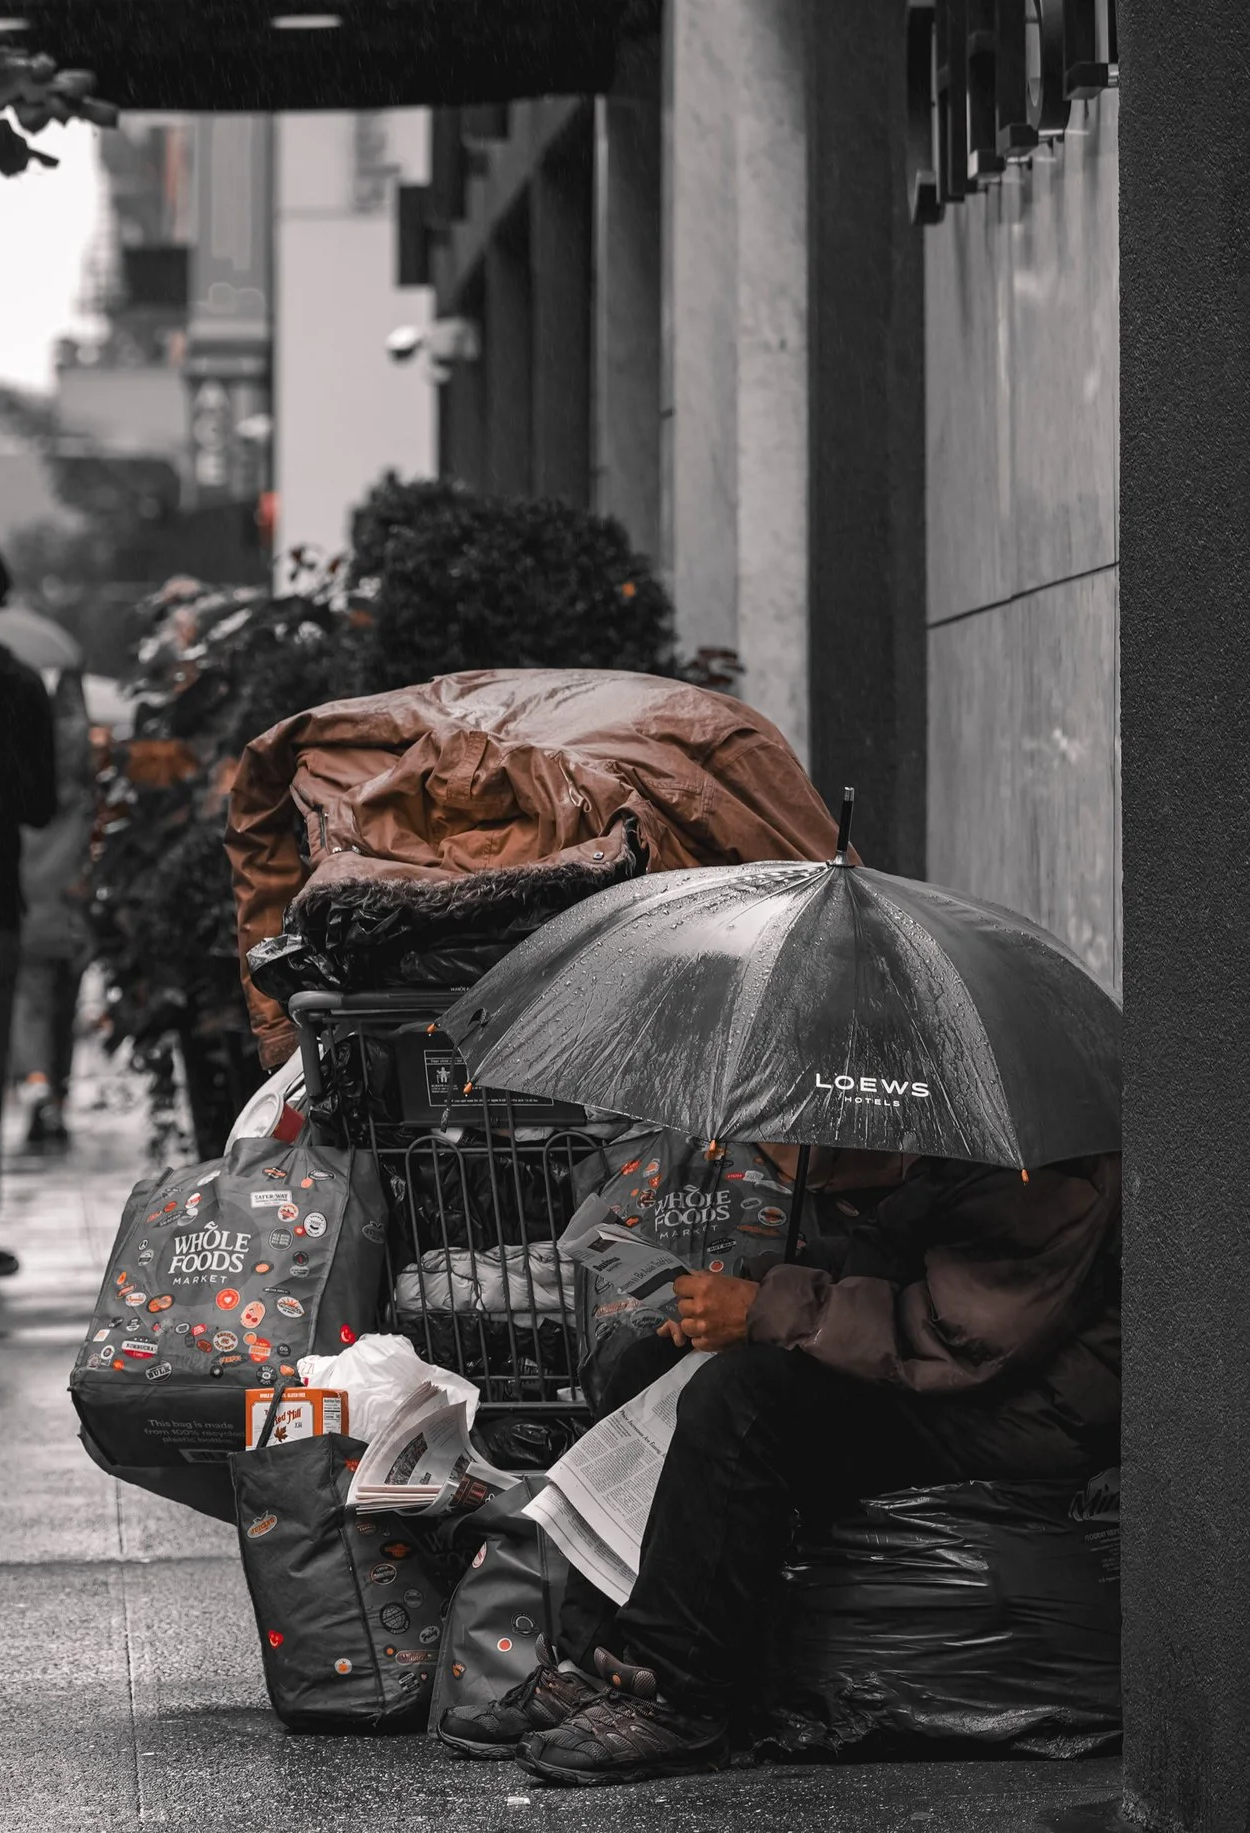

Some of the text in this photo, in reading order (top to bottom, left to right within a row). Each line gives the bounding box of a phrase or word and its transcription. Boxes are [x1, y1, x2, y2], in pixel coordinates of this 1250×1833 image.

[815, 1073, 930, 1097] LOEWS
[845, 1097, 900, 1107] HOTELS
[655, 1205, 730, 1232] FOODS
[174, 1221, 251, 1255] WHOLE
[168, 1251, 245, 1275] FOODS
[173, 1274, 228, 1286] MARKET
[147, 1419, 234, 1429] This bag is made
[287, 1406, 302, 1424] Mill
[171, 1428, 199, 1436] 100%
